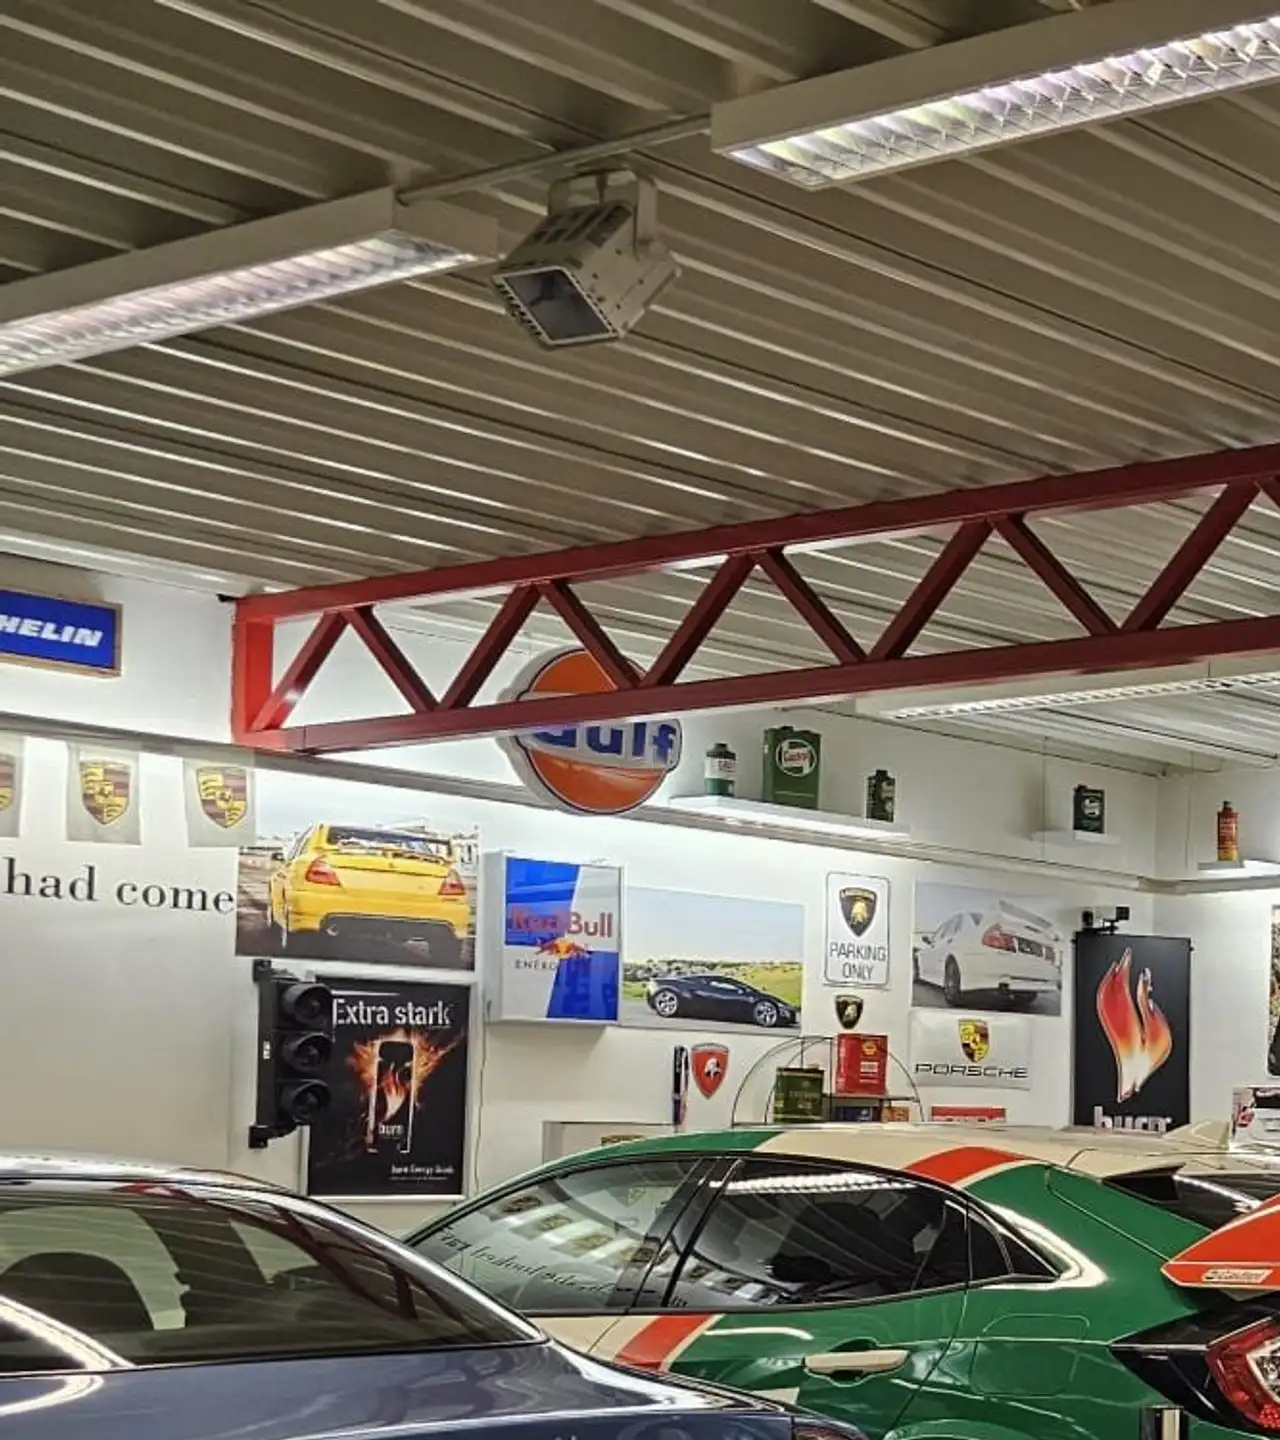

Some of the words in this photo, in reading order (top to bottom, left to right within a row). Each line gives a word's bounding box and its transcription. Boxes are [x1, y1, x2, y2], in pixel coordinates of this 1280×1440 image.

[2, 856, 99, 902] had
[116, 880, 235, 915] come
[567, 912, 613, 938] Bull
[829, 941, 886, 961] PARKING
[842, 963, 875, 981] ONLY
[332, 999, 389, 1025] Extra
[395, 1000, 451, 1025] stark
[915, 1063, 1028, 1078] PORSCHE
